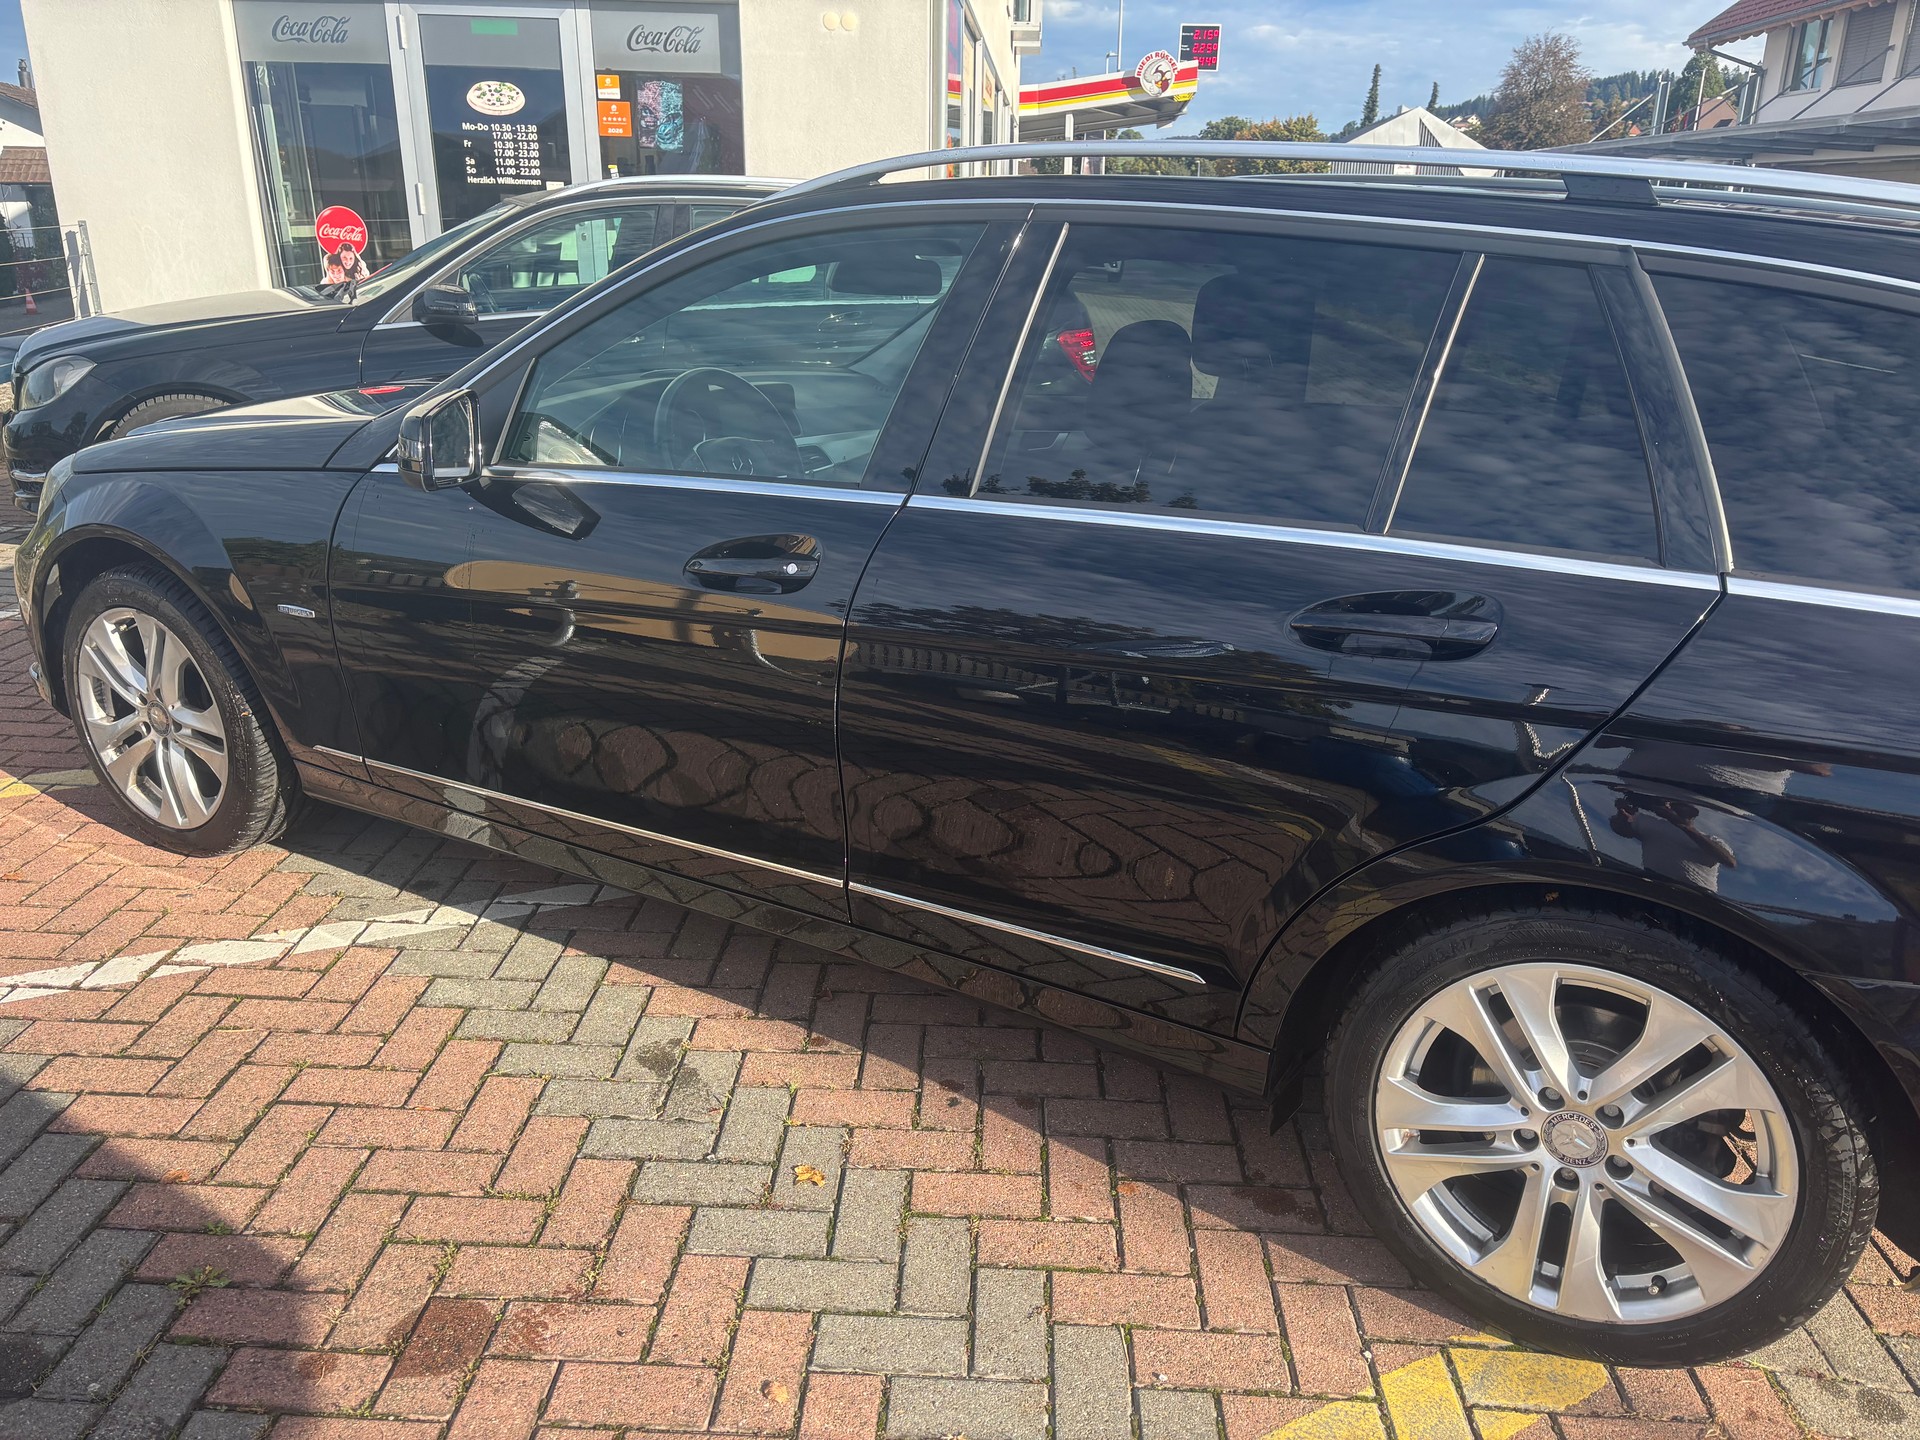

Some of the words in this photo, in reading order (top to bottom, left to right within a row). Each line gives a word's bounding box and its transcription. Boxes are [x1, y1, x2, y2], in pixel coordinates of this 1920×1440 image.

[272, 15, 351, 43] Coca-Cola
[627, 24, 704, 53] Coca-Cola
[1136, 54, 1154, 77] RUEDI
[462, 122, 489, 131] Mo-Do
[465, 157, 475, 165] Sa
[466, 166, 476, 174] So
[467, 176, 496, 184] Herzlich
[497, 177, 542, 185] Willkommen
[319, 223, 364, 241] Coca-Cola
[1550, 1113, 1596, 1128] MERCEDES
[1563, 1156, 1588, 1165] BENZ
